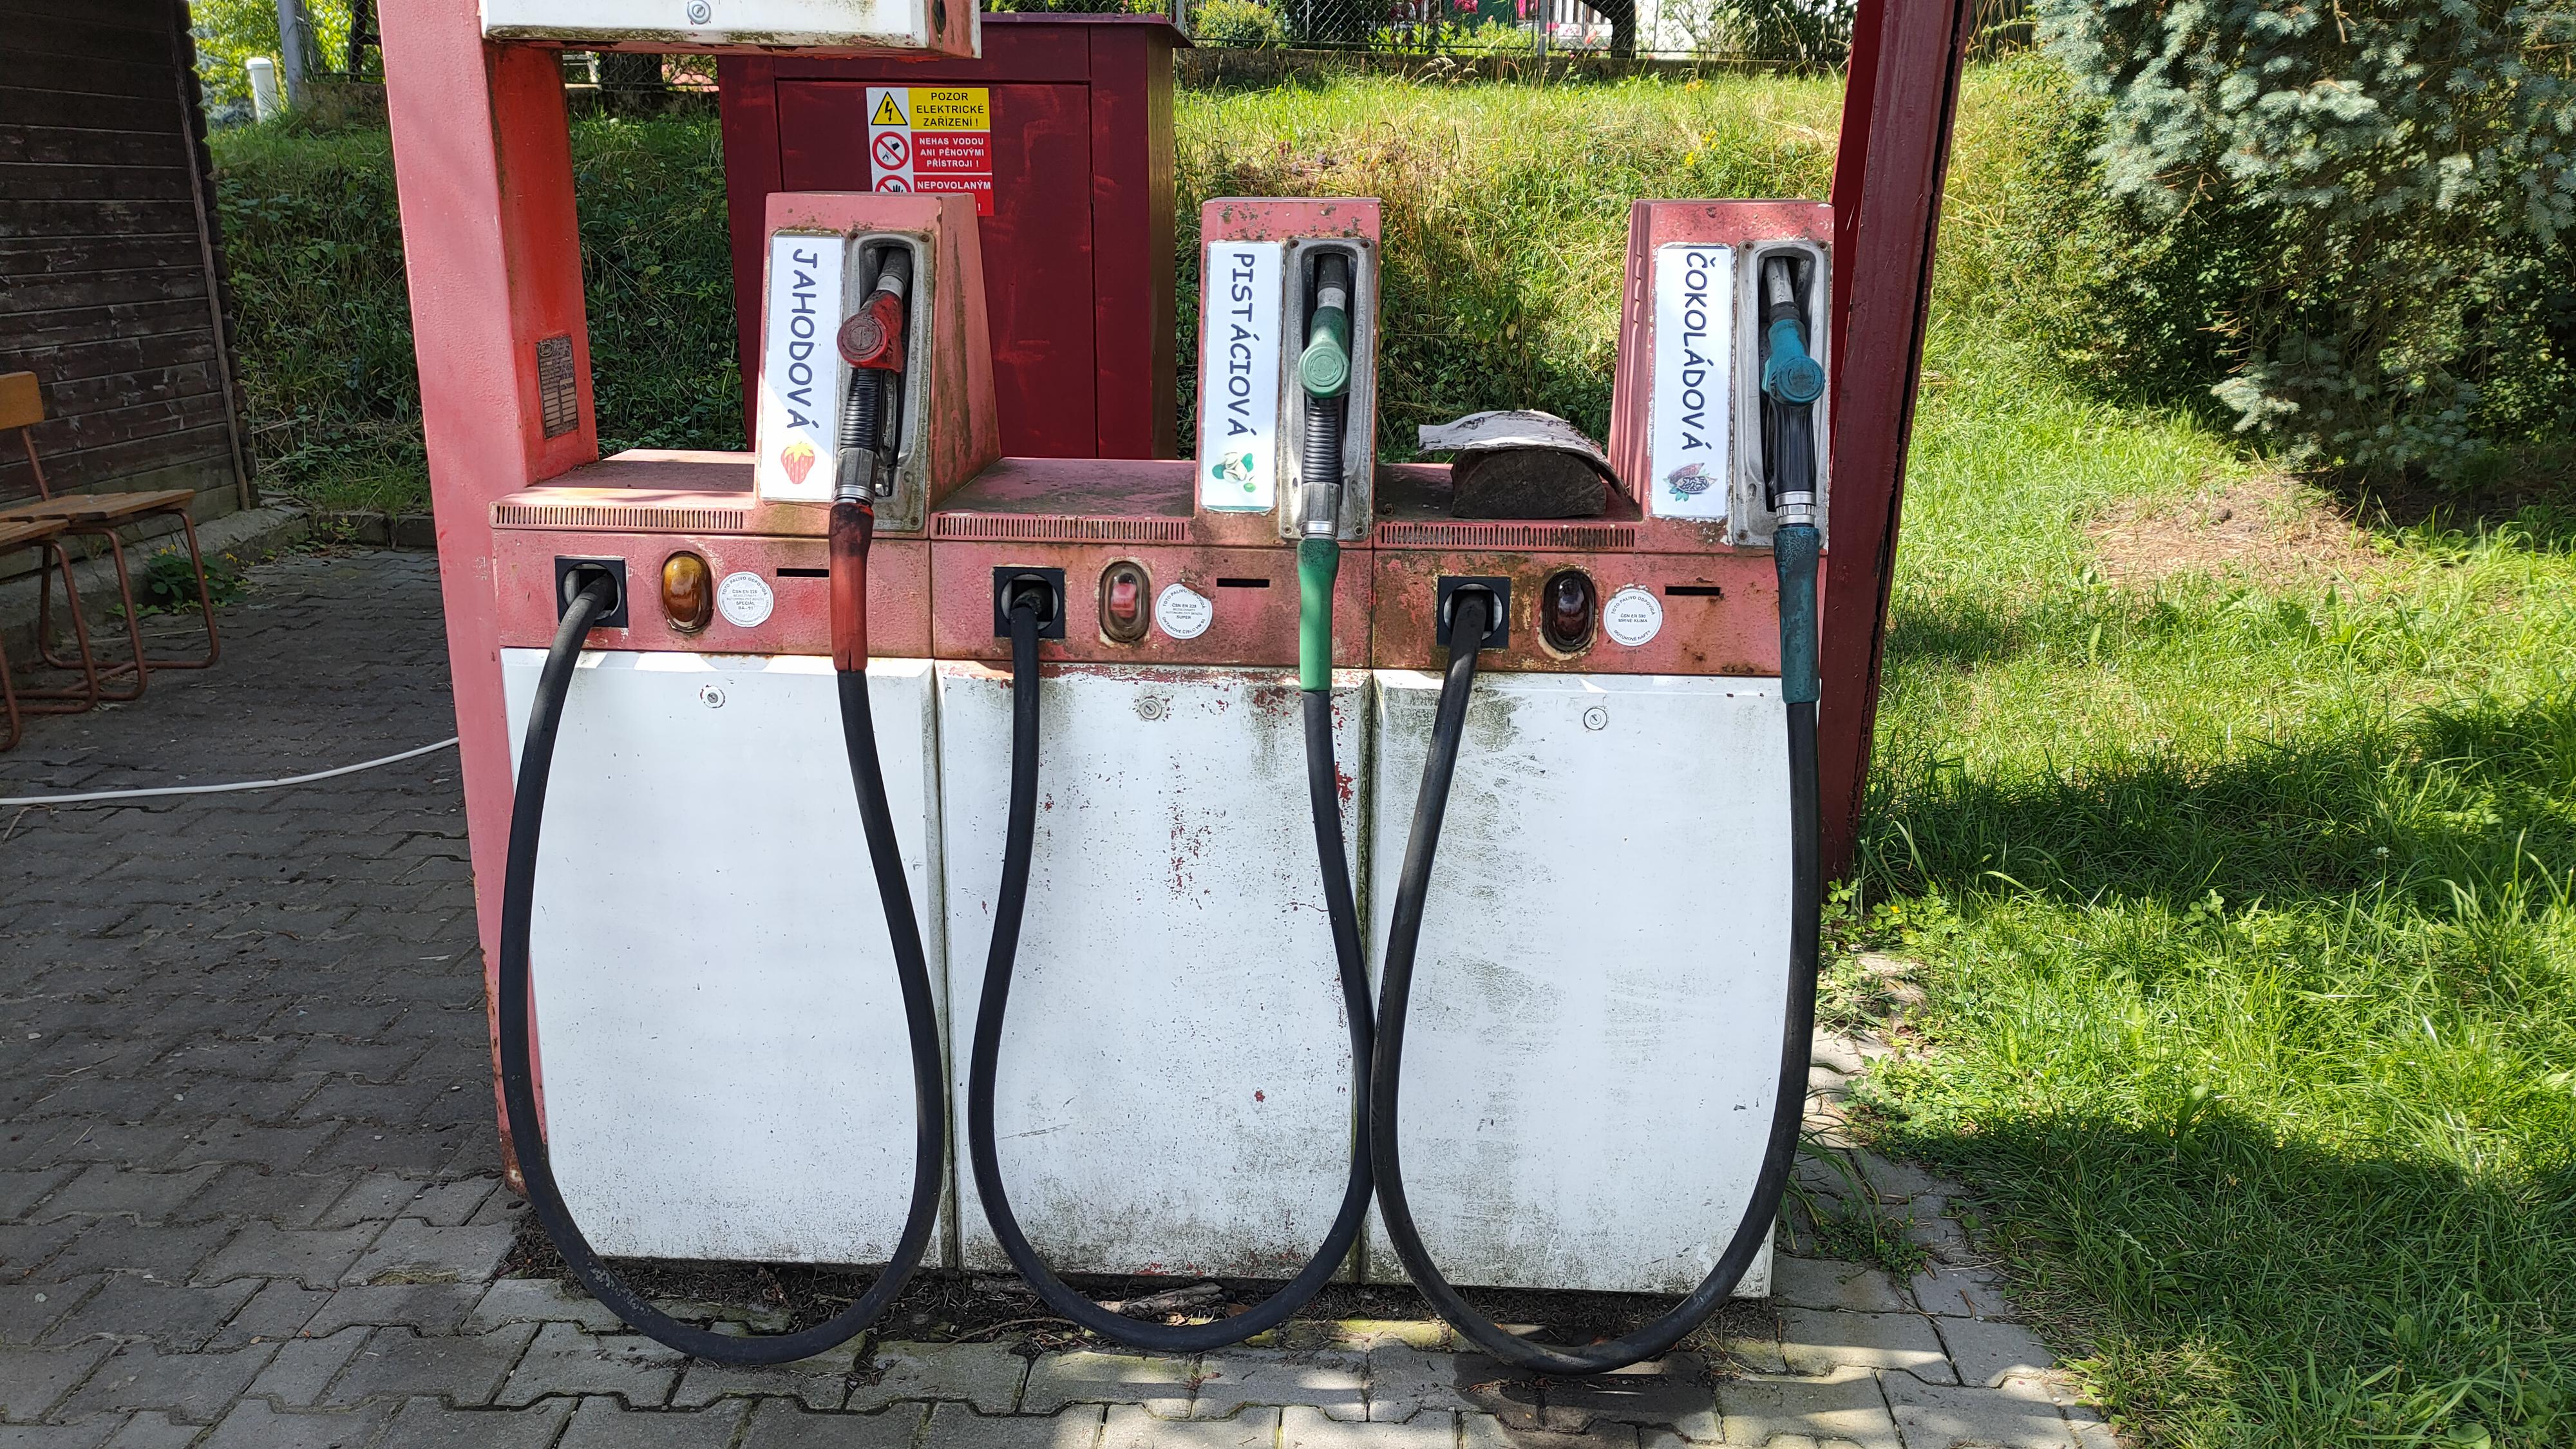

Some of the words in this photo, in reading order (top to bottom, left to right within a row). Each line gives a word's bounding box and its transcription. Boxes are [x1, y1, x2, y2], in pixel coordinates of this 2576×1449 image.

[931, 92, 969, 101] POZOR
[916, 103, 984, 114] ELEKTRICKÉ
[923, 116, 972, 126] ZAŘÍZENÍ
[939, 147, 984, 156] PĚNOVÝMI
[927, 158, 972, 167] PŘÍSTROJI
[917, 180, 991, 189] NEPOVOLANÝM
[786, 248, 819, 430] JAHODOVÁ
[1227, 252, 1260, 437] PISTÁCIOVÁ
[1681, 251, 1716, 451] ČOKOLÁDOVÁ
[1162, 596, 1171, 607] TOTO
[1611, 602, 1620, 614] TOTO
[1638, 630, 1651, 639] NAFTY
